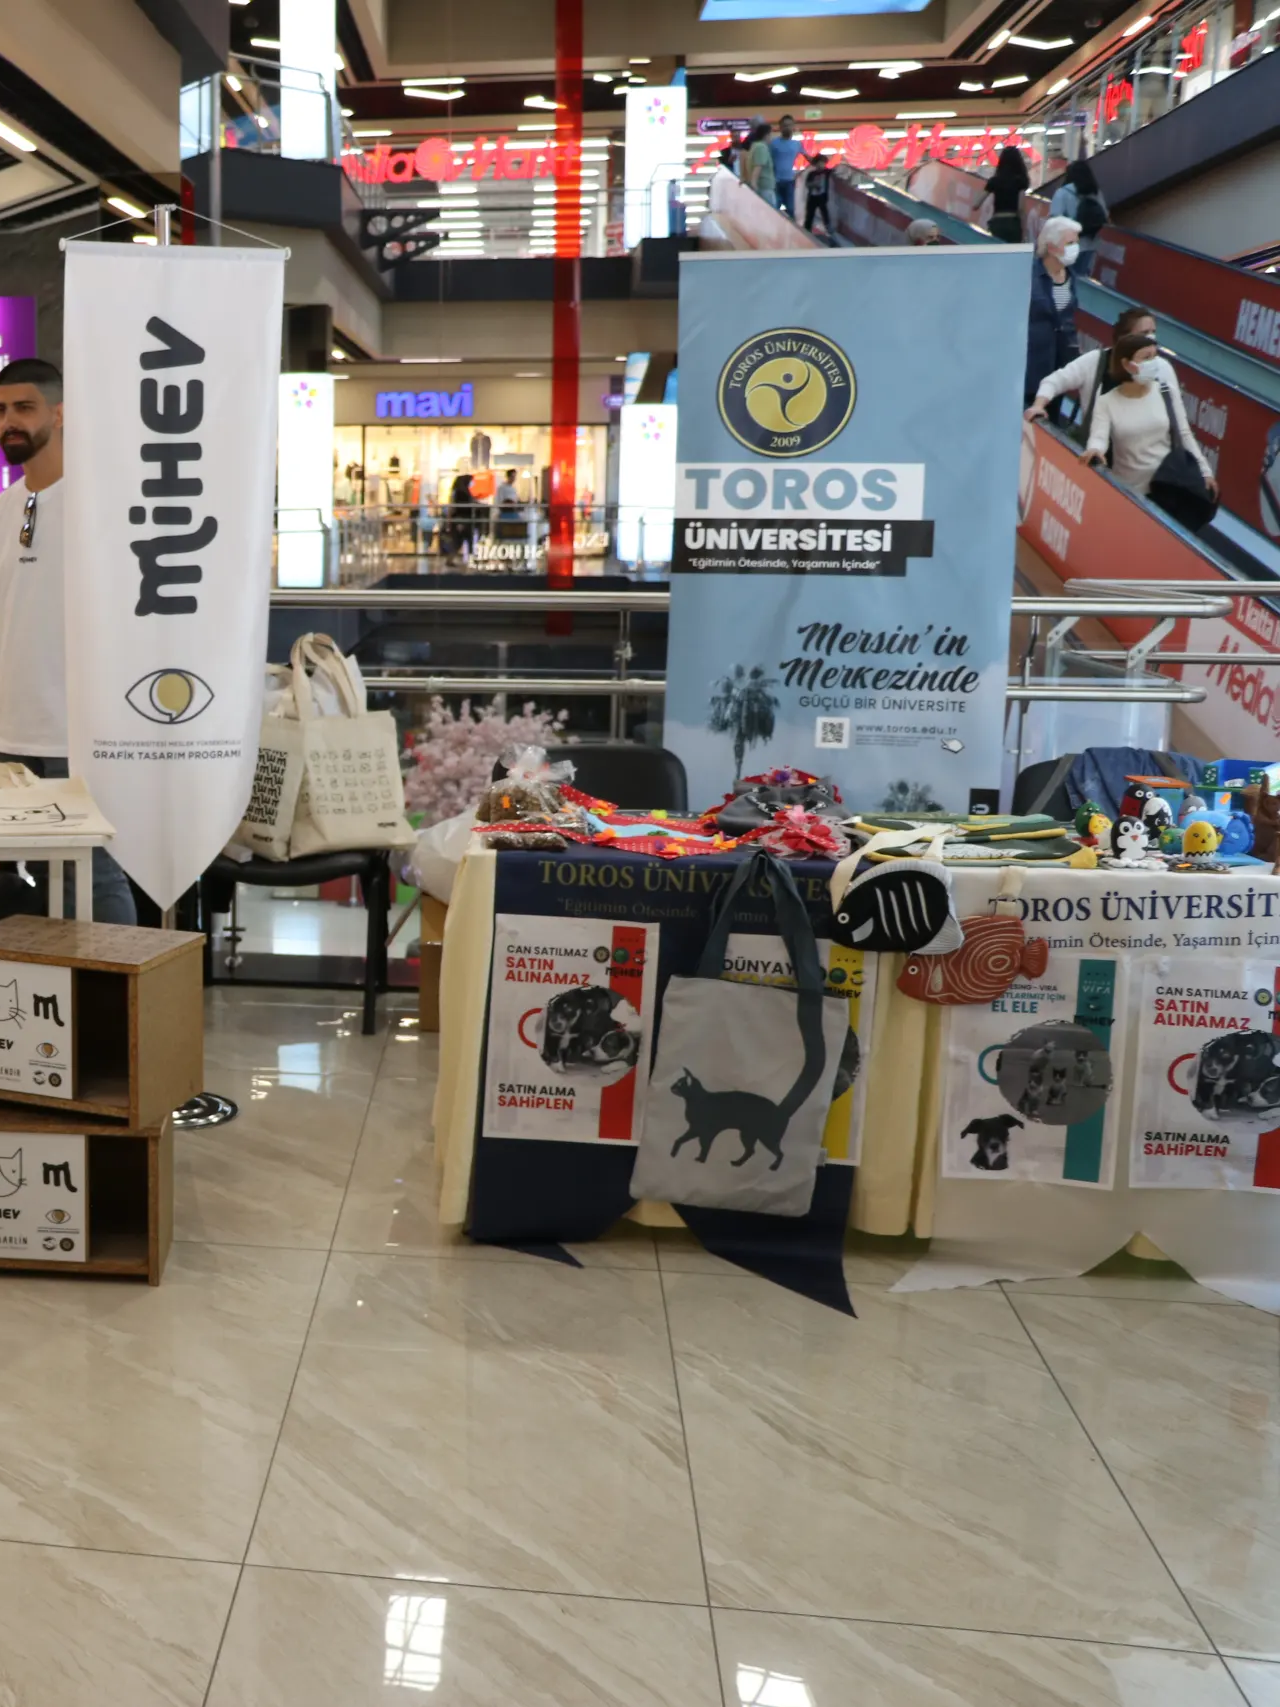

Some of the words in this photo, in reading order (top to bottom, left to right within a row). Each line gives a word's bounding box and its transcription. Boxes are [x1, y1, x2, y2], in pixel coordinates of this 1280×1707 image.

[728, 348, 765, 389] TOROS
[764, 339, 846, 388] ÜNİVERSİTESİ
[376, 383, 473, 418] mavi
[770, 436, 800, 447] 2009
[685, 468, 897, 511] TOROS
[685, 522, 892, 552] ÜNİVERSİTESİ
[738, 557, 789, 569] Ötesinde,
[792, 559, 840, 571] Yaşamın
[779, 657, 979, 693] Merkezinde
[799, 695, 850, 711] GÜÇLÜ
[855, 696, 876, 709] BİR
[882, 697, 966, 713] ÜNİVERSİTE
[855, 724, 957, 735] www.toros.edu.tr
[93, 750, 134, 760] GRAFİK
[138, 751, 185, 760] TASARIM
[188, 750, 241, 760] PROGRAMI
[538, 860, 635, 889] TOROS
[1101, 887, 1280, 921] ÜNİVERSİT
[1089, 932, 1167, 949] Ötesinde,
[1173, 932, 1241, 950] Yaşamın
[1247, 929, 1280, 947] İçin
[506, 945, 531, 955] CAN
[534, 946, 588, 958] SATILMAZ
[506, 956, 554, 971] SATIN
[722, 956, 795, 975] DÜNYAY
[505, 970, 590, 987] ALINAMAZ
[1156, 986, 1183, 996] CAN
[1186, 988, 1248, 1000] SATILMAZ
[991, 1001, 1008, 1013] EL
[1012, 1001, 1039, 1014] ELE
[1154, 998, 1209, 1013] SATIN
[1153, 1012, 1251, 1030] ALINAMAZ
[498, 1083, 536, 1095] SATIN
[539, 1086, 576, 1097] ALMA
[1144, 1131, 1186, 1142] SATIN
[1189, 1133, 1230, 1144] ALMA
